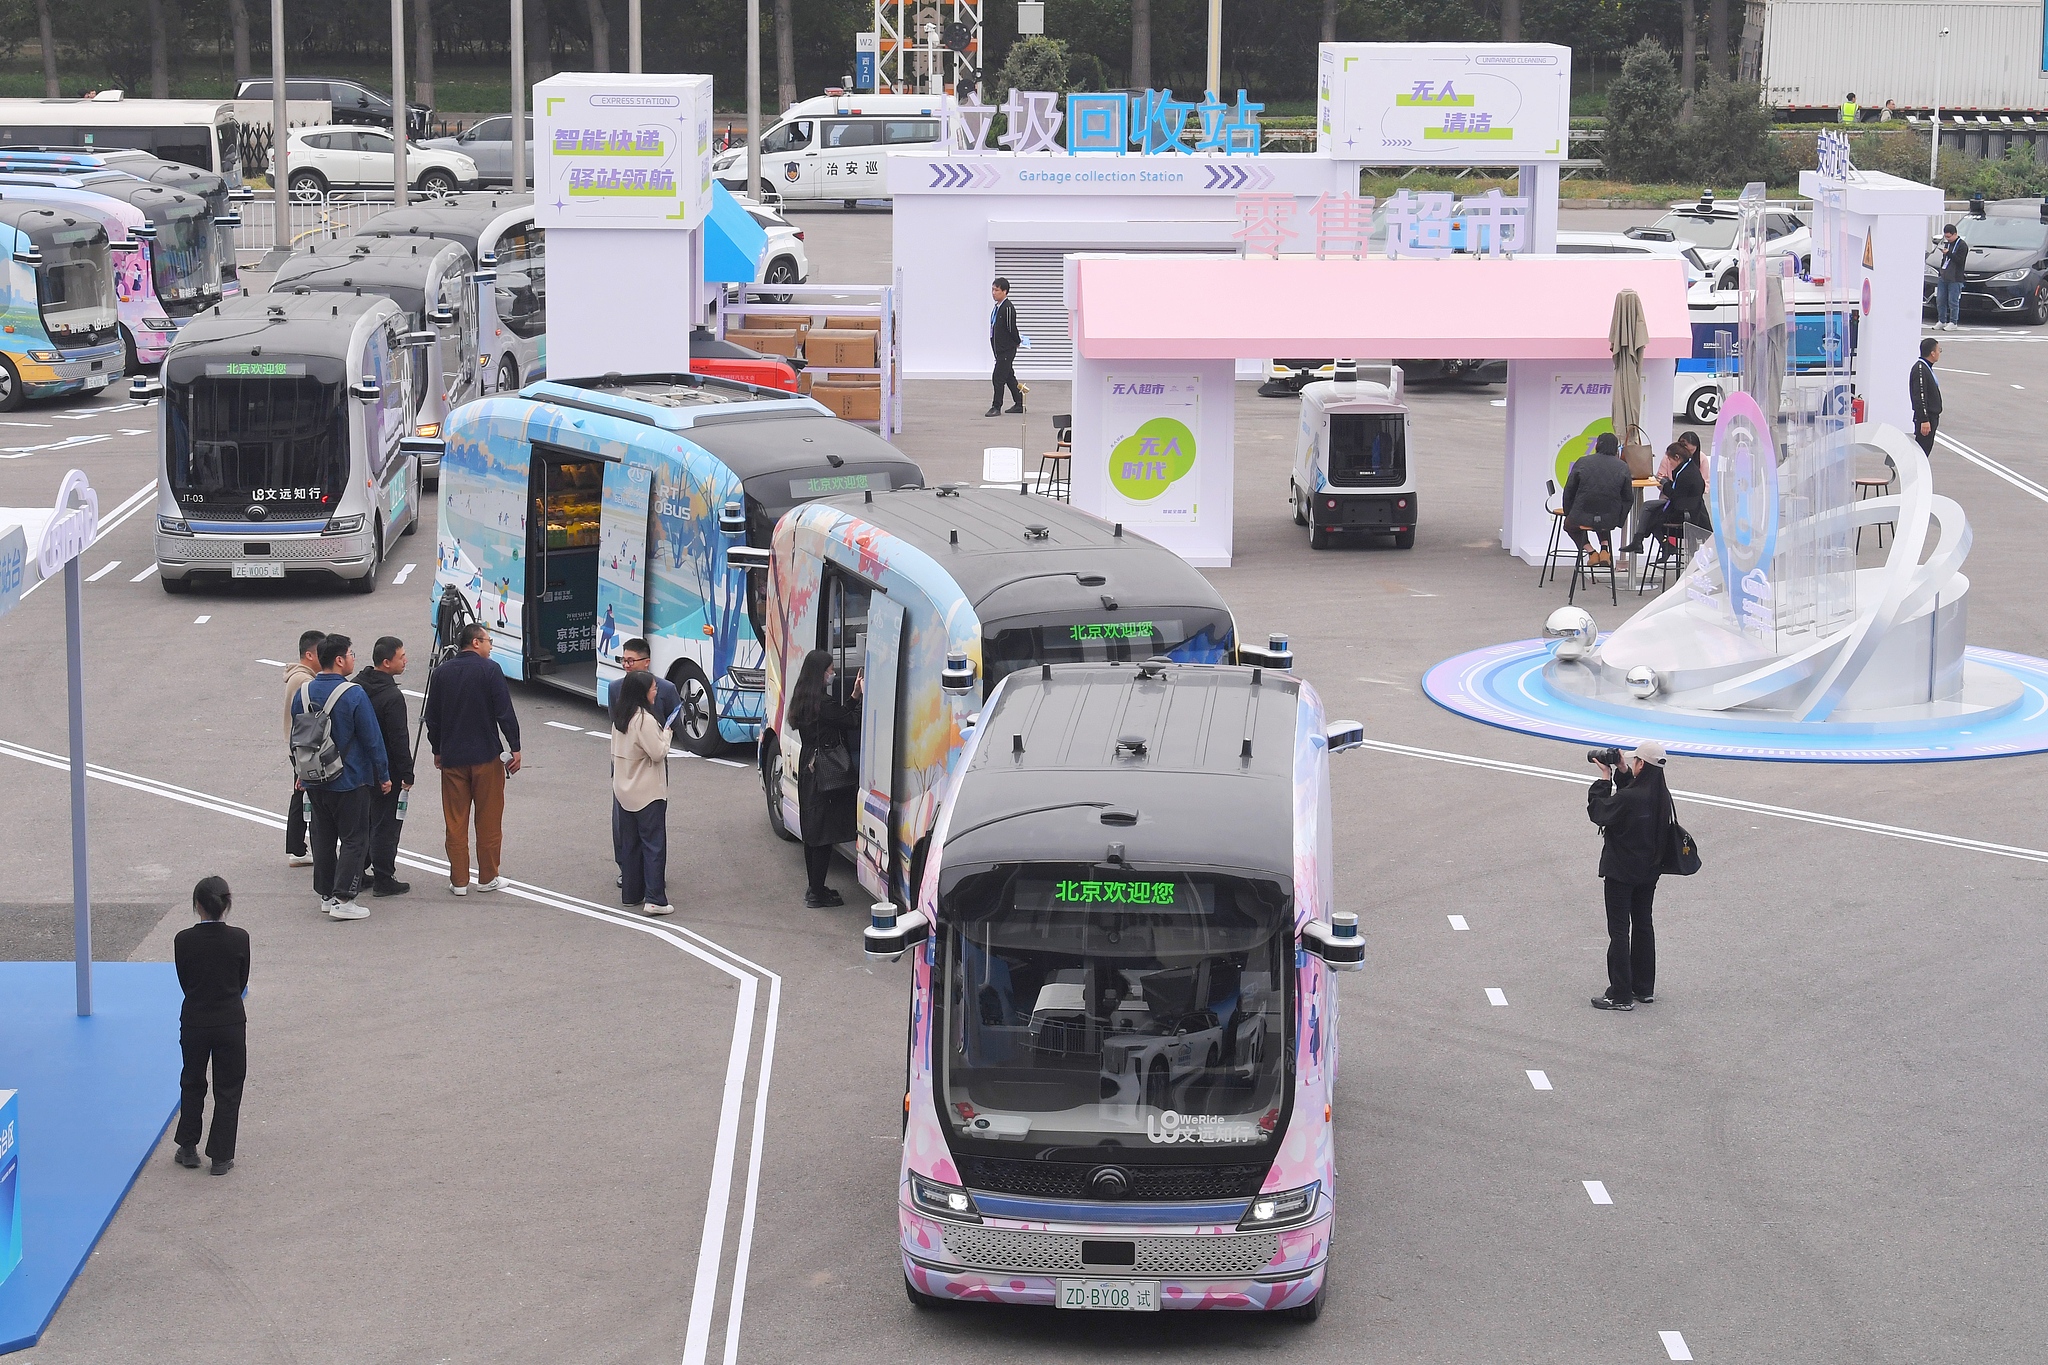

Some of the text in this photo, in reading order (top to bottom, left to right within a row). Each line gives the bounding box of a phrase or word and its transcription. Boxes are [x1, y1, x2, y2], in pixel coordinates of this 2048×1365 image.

[859, 38, 873, 46] W2
[1410, 80, 1458, 102] 无人
[601, 97, 671, 105] EXPRESS STATION
[931, 88, 1264, 156] 垃圾回收站
[1442, 112, 1493, 133] 清洁
[554, 128, 660, 151] 智能快递
[826, 160, 879, 176] 治安巡
[569, 168, 675, 190] 驿站领航
[1018, 170, 1184, 184] Garbage collection Station
[1231, 189, 1529, 259] 零售超市
[226, 362, 287, 375] 北京欢迎您
[1112, 383, 1165, 395] 无人超市
[1559, 383, 1613, 395] 无人超市
[1138, 437, 1183, 456] 无人
[1121, 461, 1167, 480] 时代
[807, 474, 869, 492] 北京欢迎您
[181, 494, 204, 503] JT-03
[264, 487, 321, 501] 文远知行
[1069, 620, 1154, 641] 北京欢迎您
[1055, 880, 1175, 904] 北京欢迎您
[1179, 1114, 1225, 1125] WeRide
[1178, 1126, 1251, 1143] 文远知行
[1137, 1290, 1151, 1307] 试
